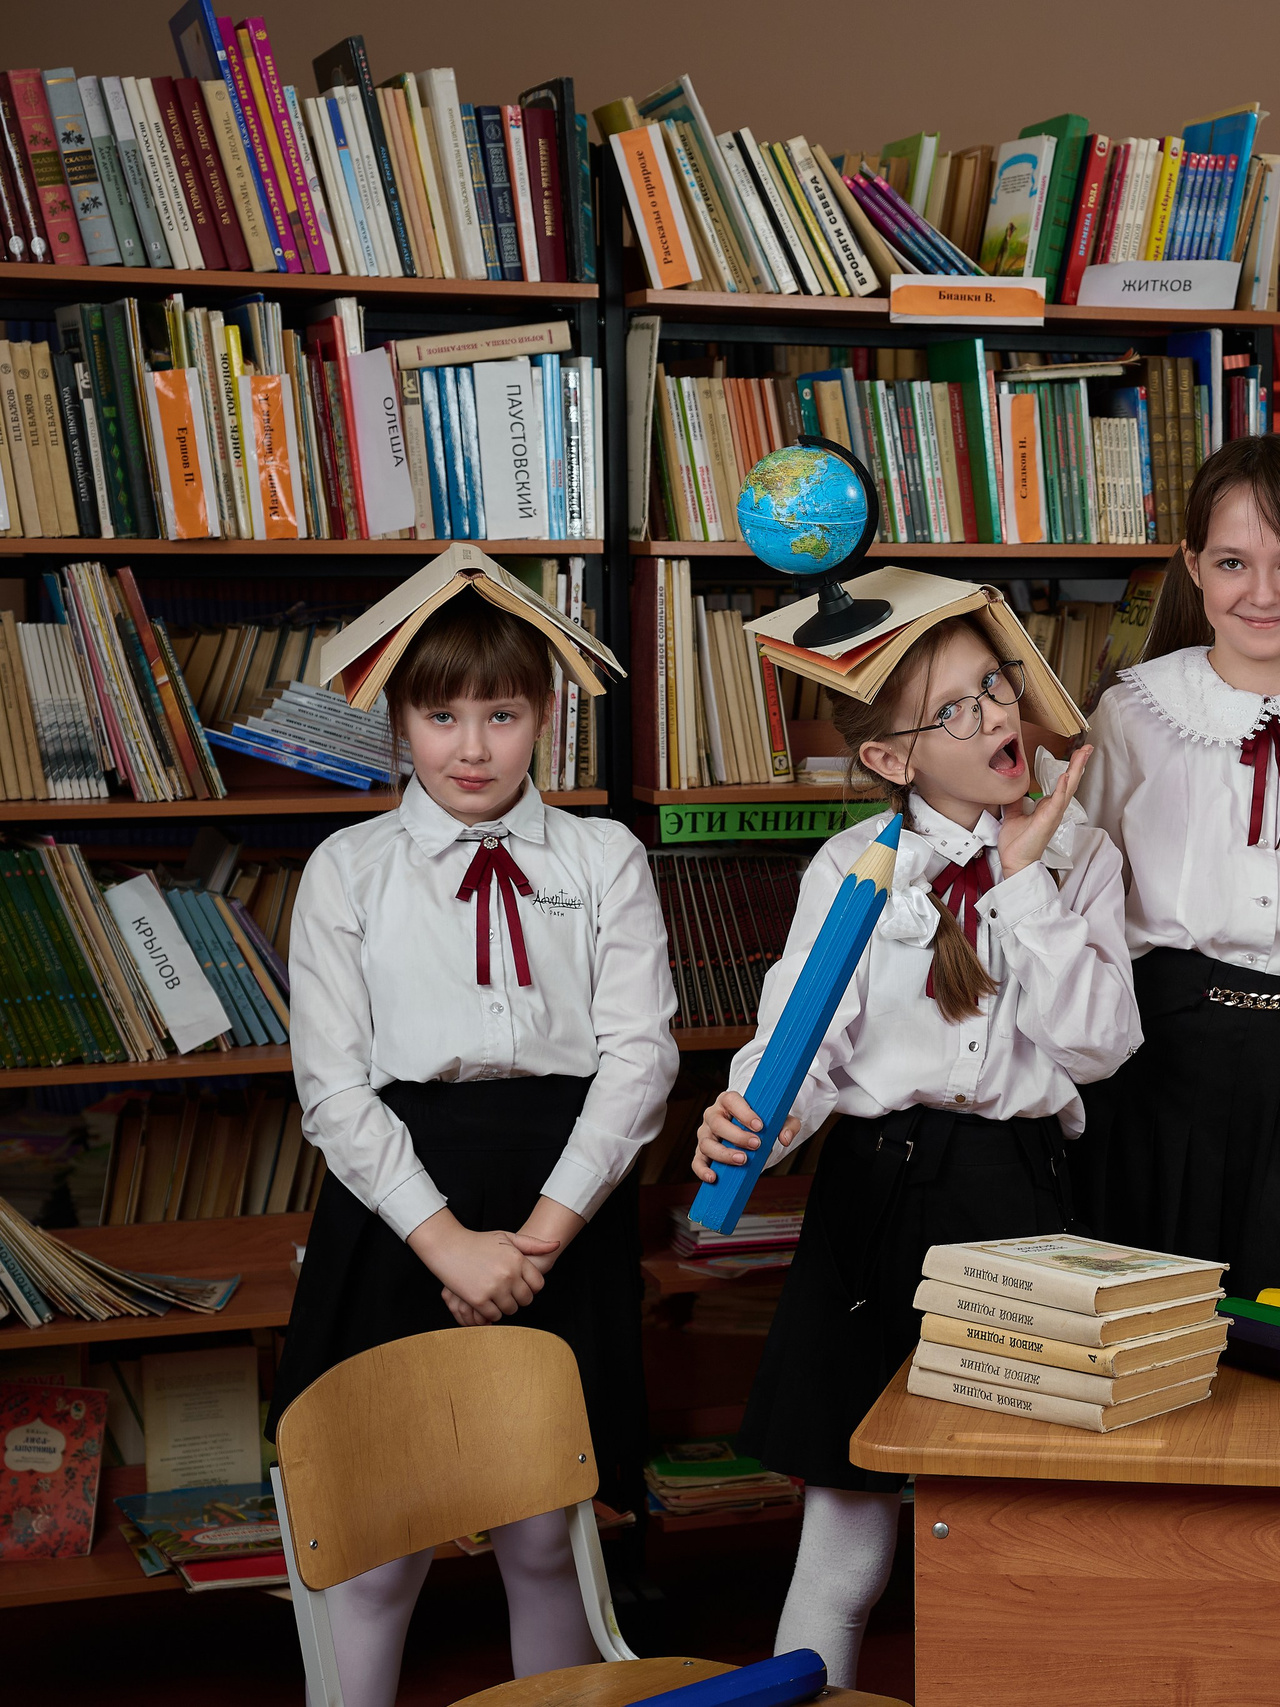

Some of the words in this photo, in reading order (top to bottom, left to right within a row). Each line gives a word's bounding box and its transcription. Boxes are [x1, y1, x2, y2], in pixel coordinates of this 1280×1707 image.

[264, 54, 286, 112] РОССИИ
[137, 120, 152, 152] РОССИИ
[152, 120, 167, 152] РОССИИ
[226, 44, 249, 99] СКАЗКИ
[243, 105, 269, 172] НАРОДОВ
[263, 177, 287, 235] РОССИИ
[178, 152, 190, 167] ЗА
[203, 152, 215, 166] ЗА
[280, 118, 304, 185] НАРОДОВ
[147, 155, 165, 199] ПИСАТЕЛЕЙ
[162, 155, 180, 199] ПИСАТЕЛЕЙ
[233, 164, 245, 178] ЗА
[354, 156, 365, 179] ВЕТРОВ
[636, 150, 656, 198] природе
[650, 200, 658, 208] о
[809, 173, 840, 225] СЕВЕРА
[160, 201, 175, 231] СКАЗКИ
[176, 201, 190, 231] СКАЗКИ
[195, 211, 206, 223] ЗА
[218, 211, 230, 223] ЗА
[298, 191, 319, 245] СКАЗКИ
[1076, 212, 1093, 255] ВРЕМЕНА
[1086, 180, 1099, 207] ГОДА
[247, 224, 259, 236] ЗА
[359, 219, 368, 243] СКАЗОК
[655, 210, 673, 265] Рассказы
[832, 226, 868, 287] БРОДЯГИ
[938, 291, 982, 303] Бианки
[985, 292, 996, 303] В.
[1121, 279, 1192, 293] ЖИТКОВ
[111, 315, 129, 368] ШКАТУЛКА
[425, 341, 477, 355] ИЗБРАННОЕ
[484, 337, 516, 348] ОЛЕША
[517, 333, 544, 343] ЮРИЙ
[119, 371, 140, 446] МАЛАХИТОВАЯ
[383, 396, 404, 468] ОЛЕША
[174, 426, 194, 469] Ершов
[506, 384, 537, 519] ПАУСТОВСКИЙ
[1019, 437, 1027, 451] Н.
[183, 472, 195, 486] П.
[1019, 456, 1029, 498] Сладков
[762, 661, 779, 707] КУТУЗОВ
[664, 812, 728, 836] ЭТИ
[738, 810, 848, 833] КНИГИ
[132, 916, 180, 990] КРЫЛОВ
[964, 1266, 998, 1284] РОДНИК
[1002, 1274, 1033, 1292] ЖИВОЙ
[956, 1299, 994, 1316] РОДНИК
[999, 1308, 1034, 1326] ЖИВОЙ
[966, 1328, 1005, 1346] РОДНИК
[1009, 1336, 1044, 1354] ЖИВОЙ
[960, 1358, 1000, 1377] РОДНИК
[1088, 1353, 1098, 1364] 4
[1004, 1367, 1040, 1385] ЖИВОЙ
[952, 1383, 993, 1402] РОДНИК
[996, 1393, 1032, 1412] ЖИВОЙ
